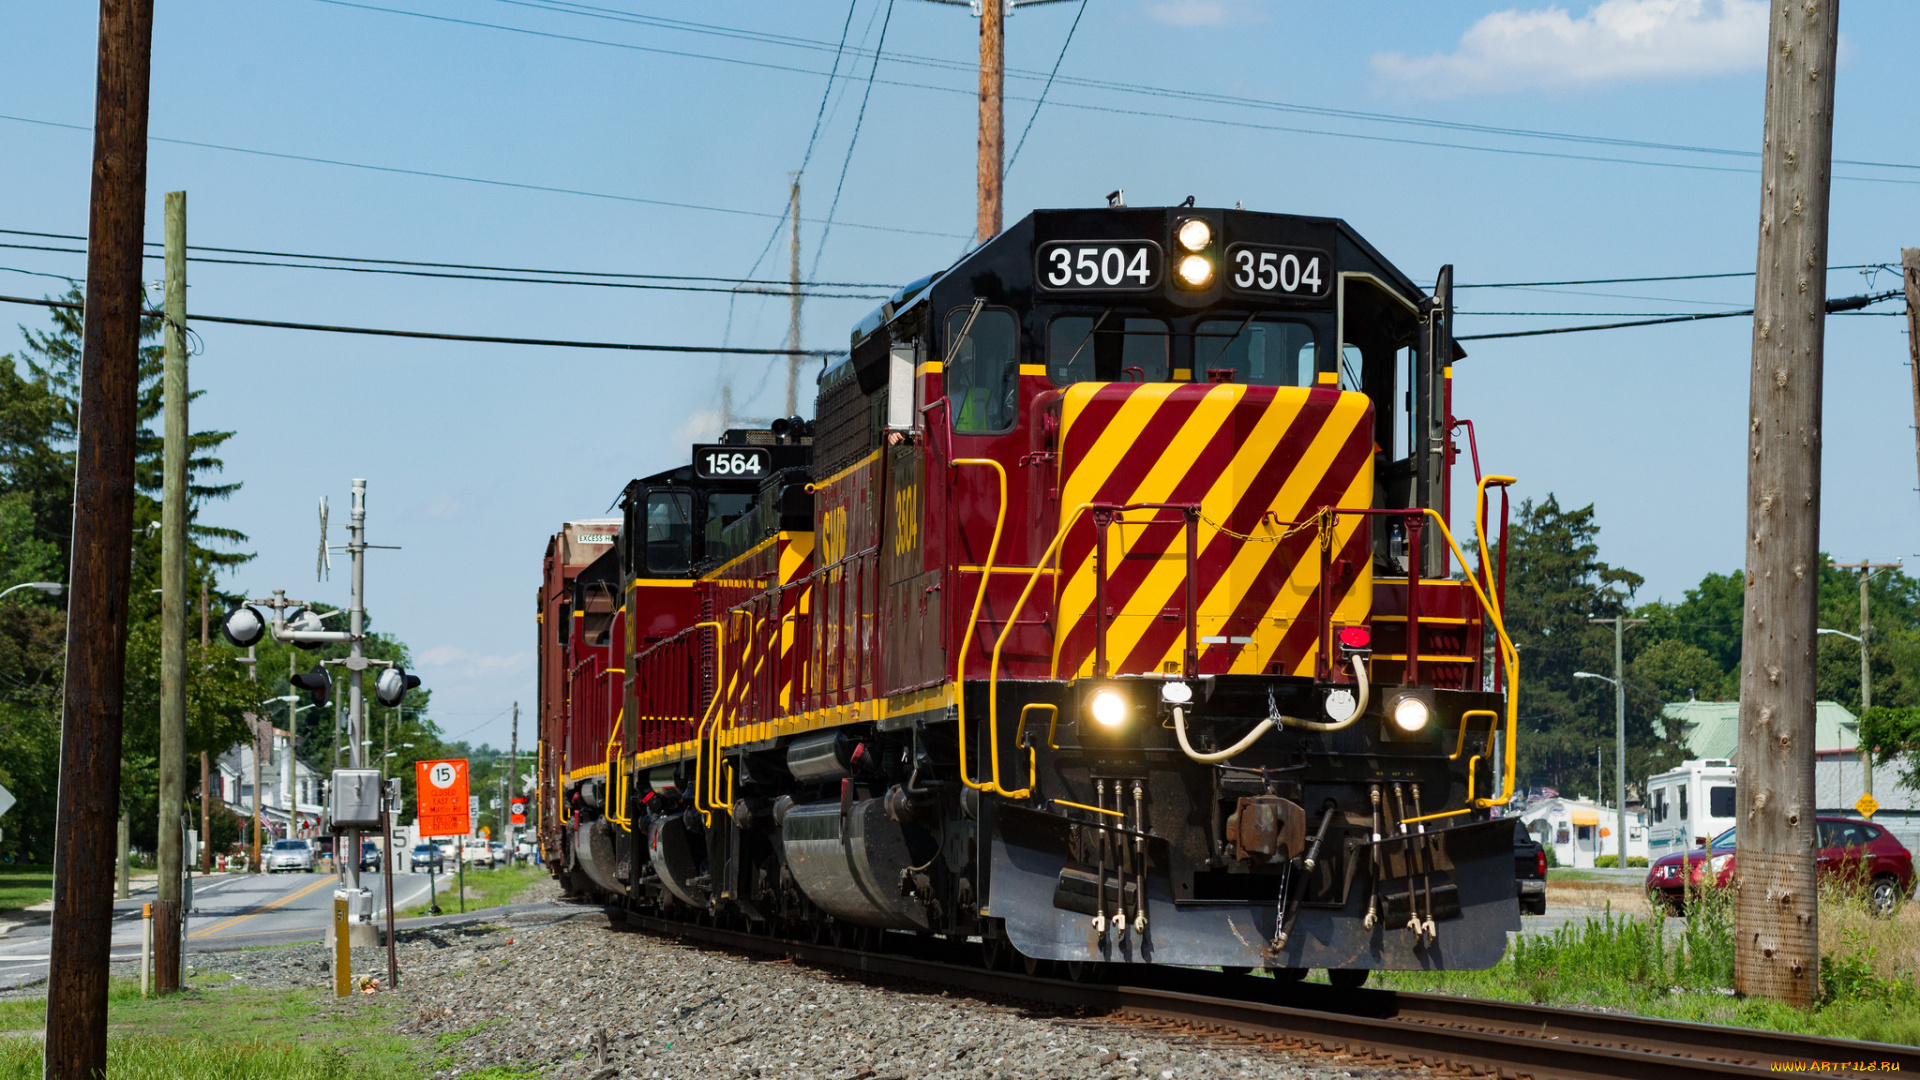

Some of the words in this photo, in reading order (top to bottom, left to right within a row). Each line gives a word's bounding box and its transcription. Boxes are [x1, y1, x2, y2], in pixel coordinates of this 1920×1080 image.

[1048, 248, 1151, 286] 3504
[1234, 250, 1322, 293] 3504
[705, 453, 761, 474] 1564
[895, 484, 917, 556] 3504
[579, 534, 603, 542] EXCESS
[436, 768, 450, 782] 15
[470, 807, 478, 817] 5
